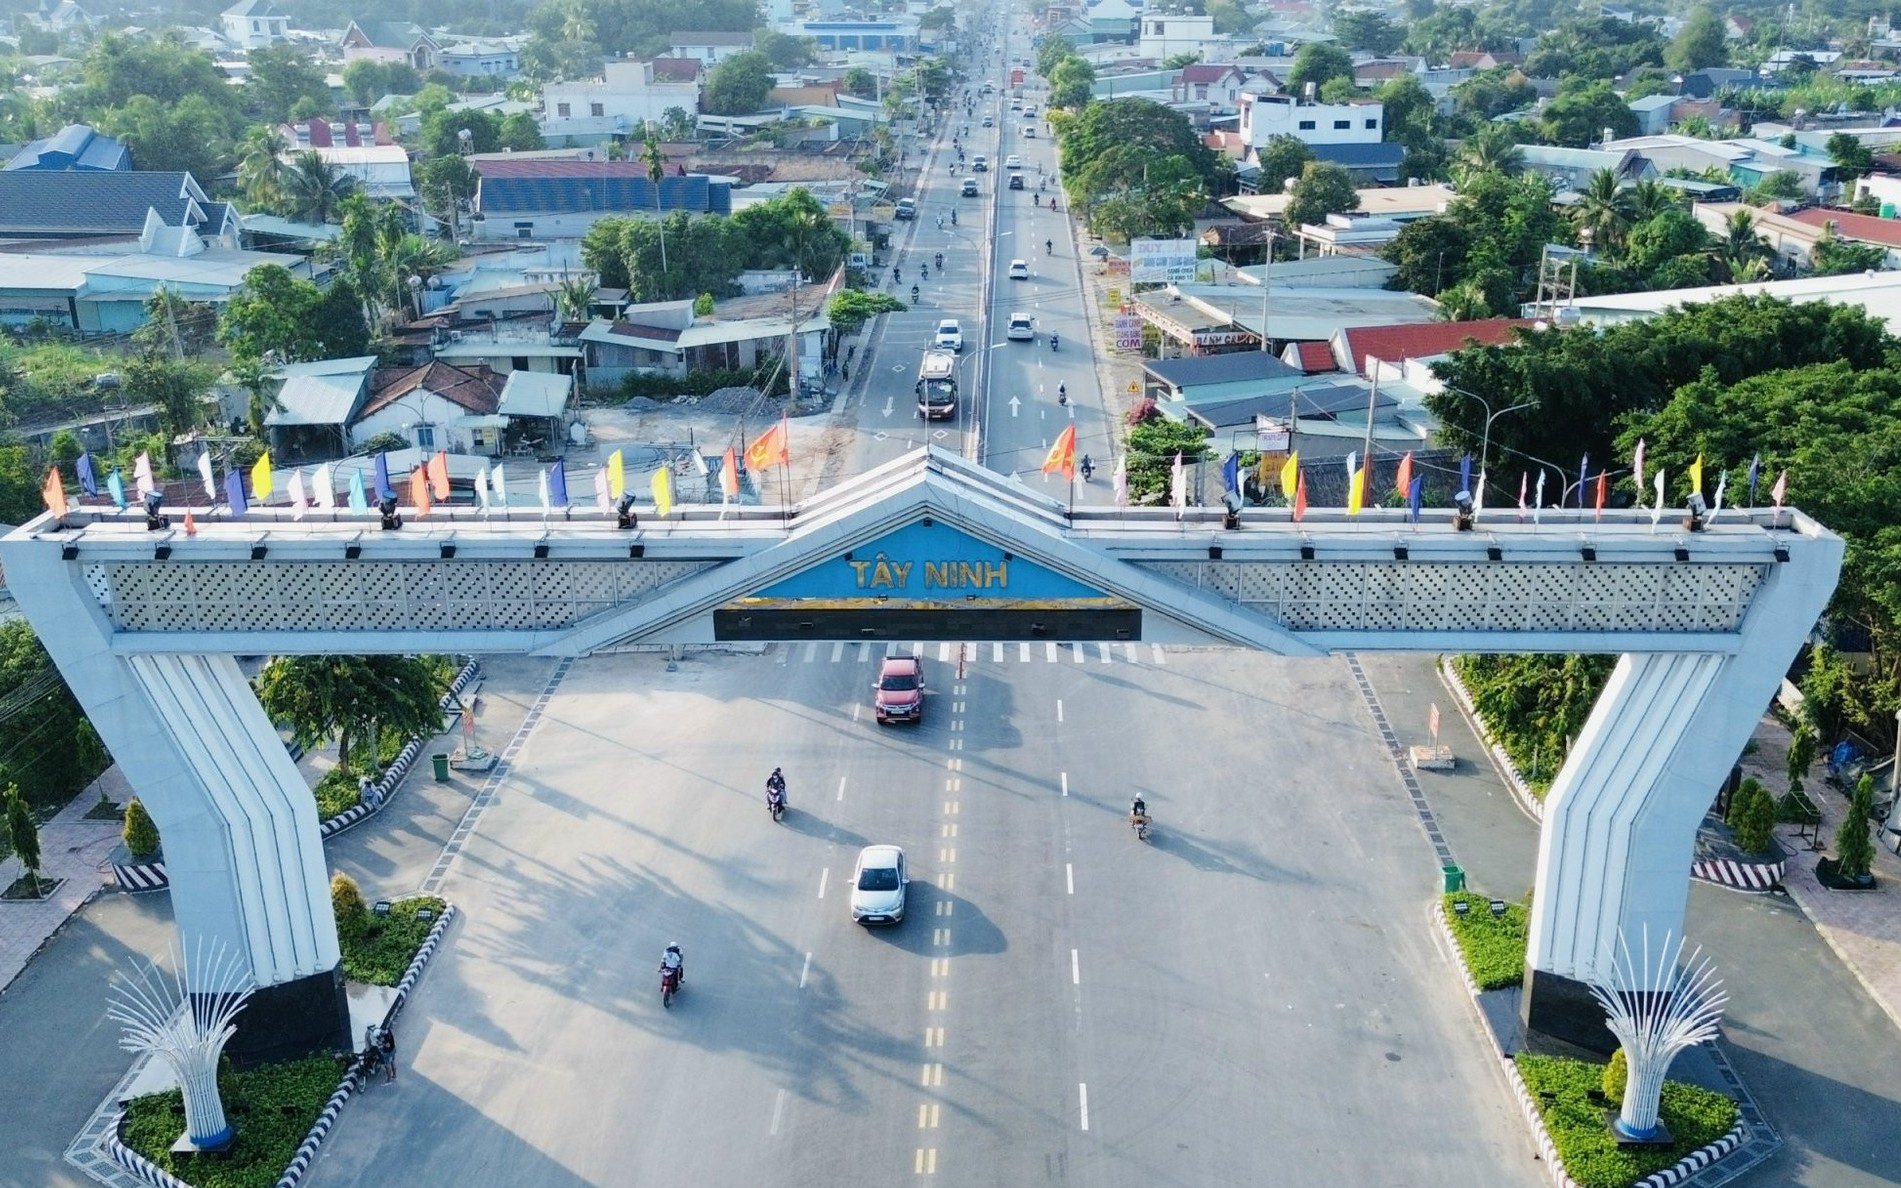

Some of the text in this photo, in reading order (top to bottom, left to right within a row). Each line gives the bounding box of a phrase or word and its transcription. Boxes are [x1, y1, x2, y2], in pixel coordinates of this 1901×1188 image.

[1138, 243, 1162, 253] DUY
[1196, 334, 1222, 346] BÁNH
[849, 552, 1007, 588] TÂY NINH
